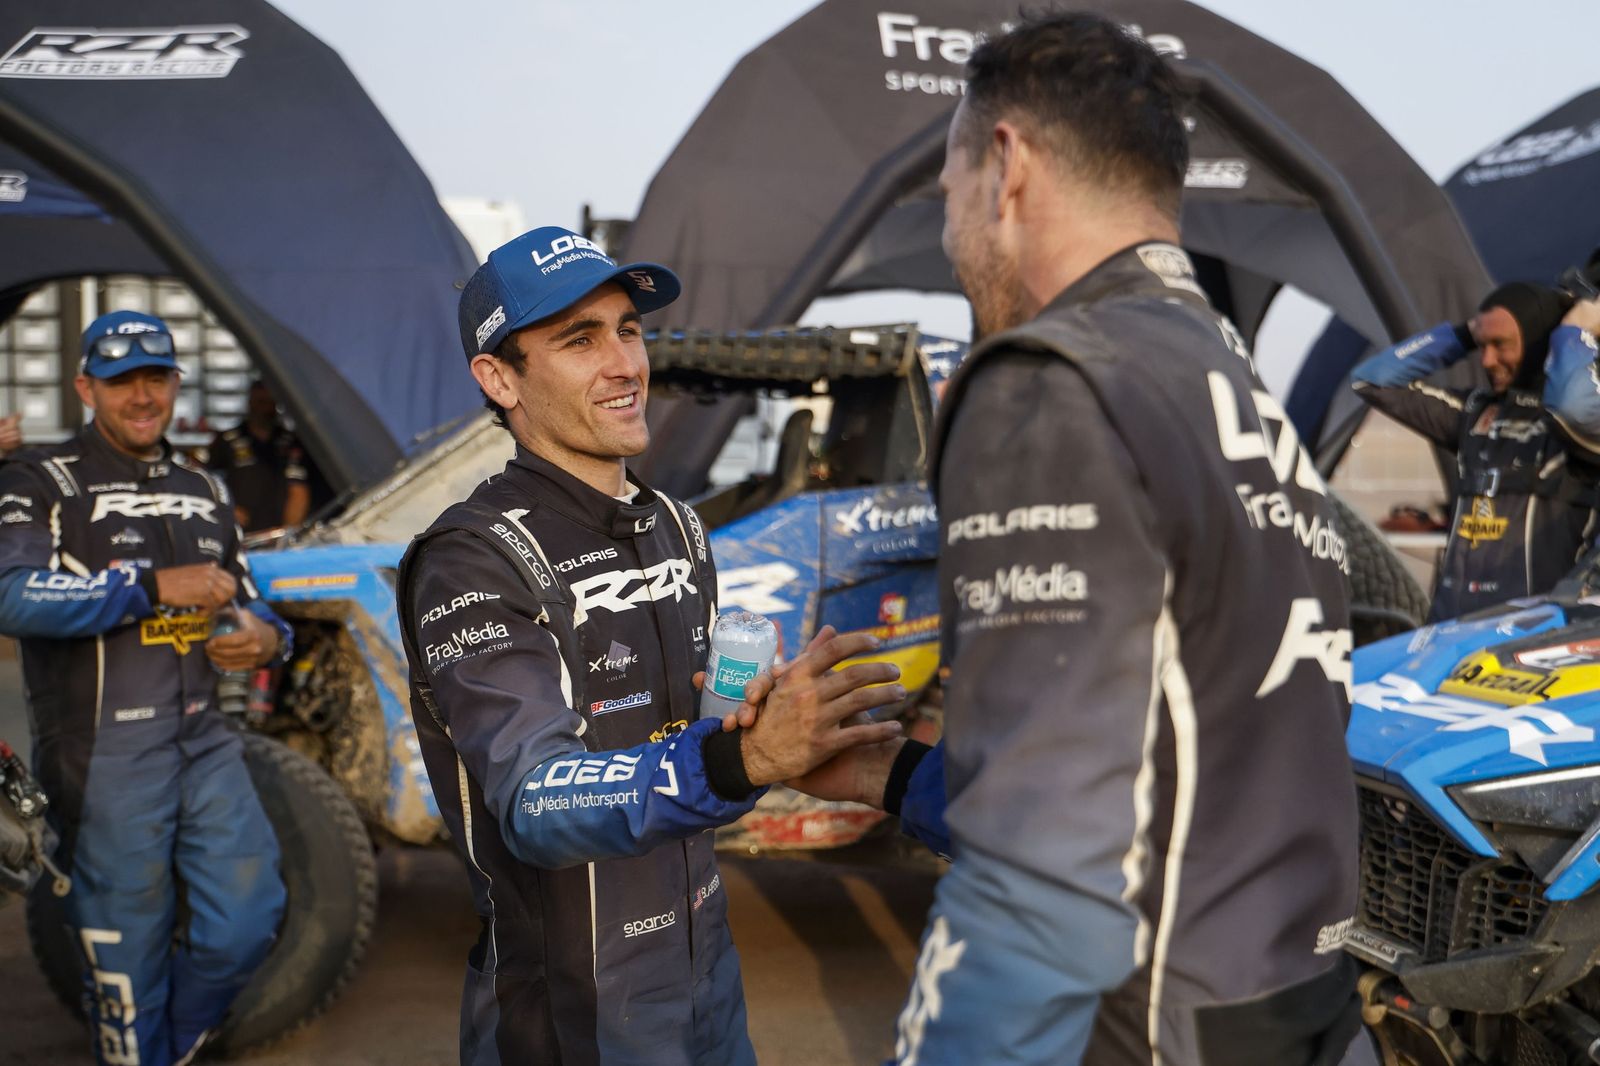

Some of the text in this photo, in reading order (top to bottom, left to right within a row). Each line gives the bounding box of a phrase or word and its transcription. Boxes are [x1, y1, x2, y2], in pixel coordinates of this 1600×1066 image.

[948, 503, 1099, 546] POLARIS
[489, 523, 551, 590] sparco
[425, 621, 510, 664] FrayMédia
[478, 641, 513, 655] FACTORY
[590, 691, 651, 713] BFGoodrich
[572, 788, 639, 809] Motorsport
[624, 911, 676, 938] sparco
